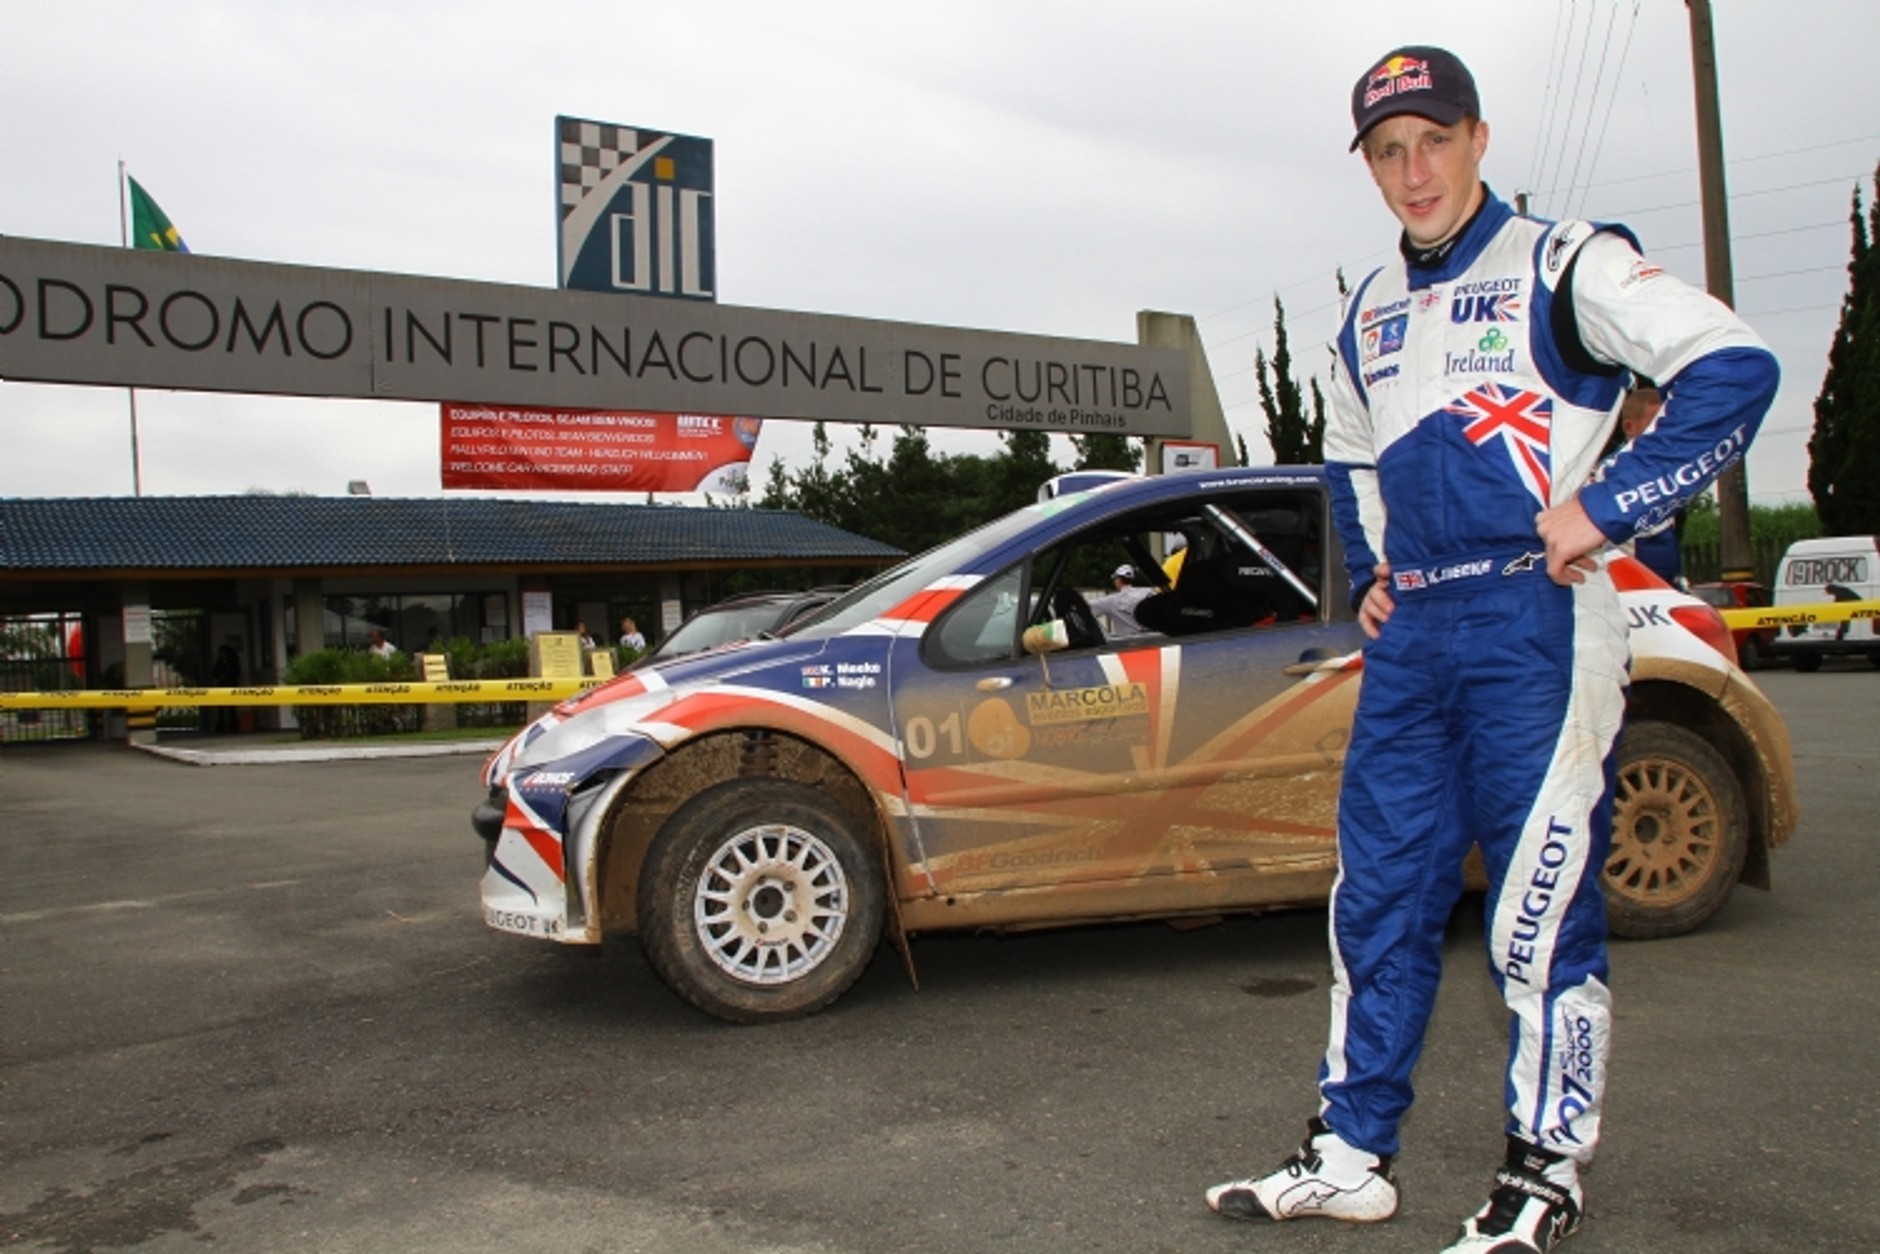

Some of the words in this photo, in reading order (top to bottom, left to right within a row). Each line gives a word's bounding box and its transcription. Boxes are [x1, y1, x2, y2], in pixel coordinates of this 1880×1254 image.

[1364, 78, 1395, 109] Red
[1397, 73, 1433, 94] Bull
[1453, 278, 1522, 297] PEUGEOT
[1451, 294, 1521, 324] UK
[384, 306, 883, 394] INTERNACIONAL
[904, 350, 963, 398] DE
[981, 356, 1173, 412] CURITIBA
[1444, 349, 1515, 376] Ireland
[986, 403, 1044, 423] Cidade
[1047, 408, 1067, 425] de
[1070, 408, 1128, 428] Pinhais
[1614, 423, 1746, 514] PEUGEOT
[1757, 612, 1817, 627] ATENÇÃO
[1030, 684, 1146, 711] MARCOLA
[904, 711, 964, 758] 01
[1506, 815, 1574, 985] PEUGEOT
[1577, 1015, 1592, 1082] 2000
